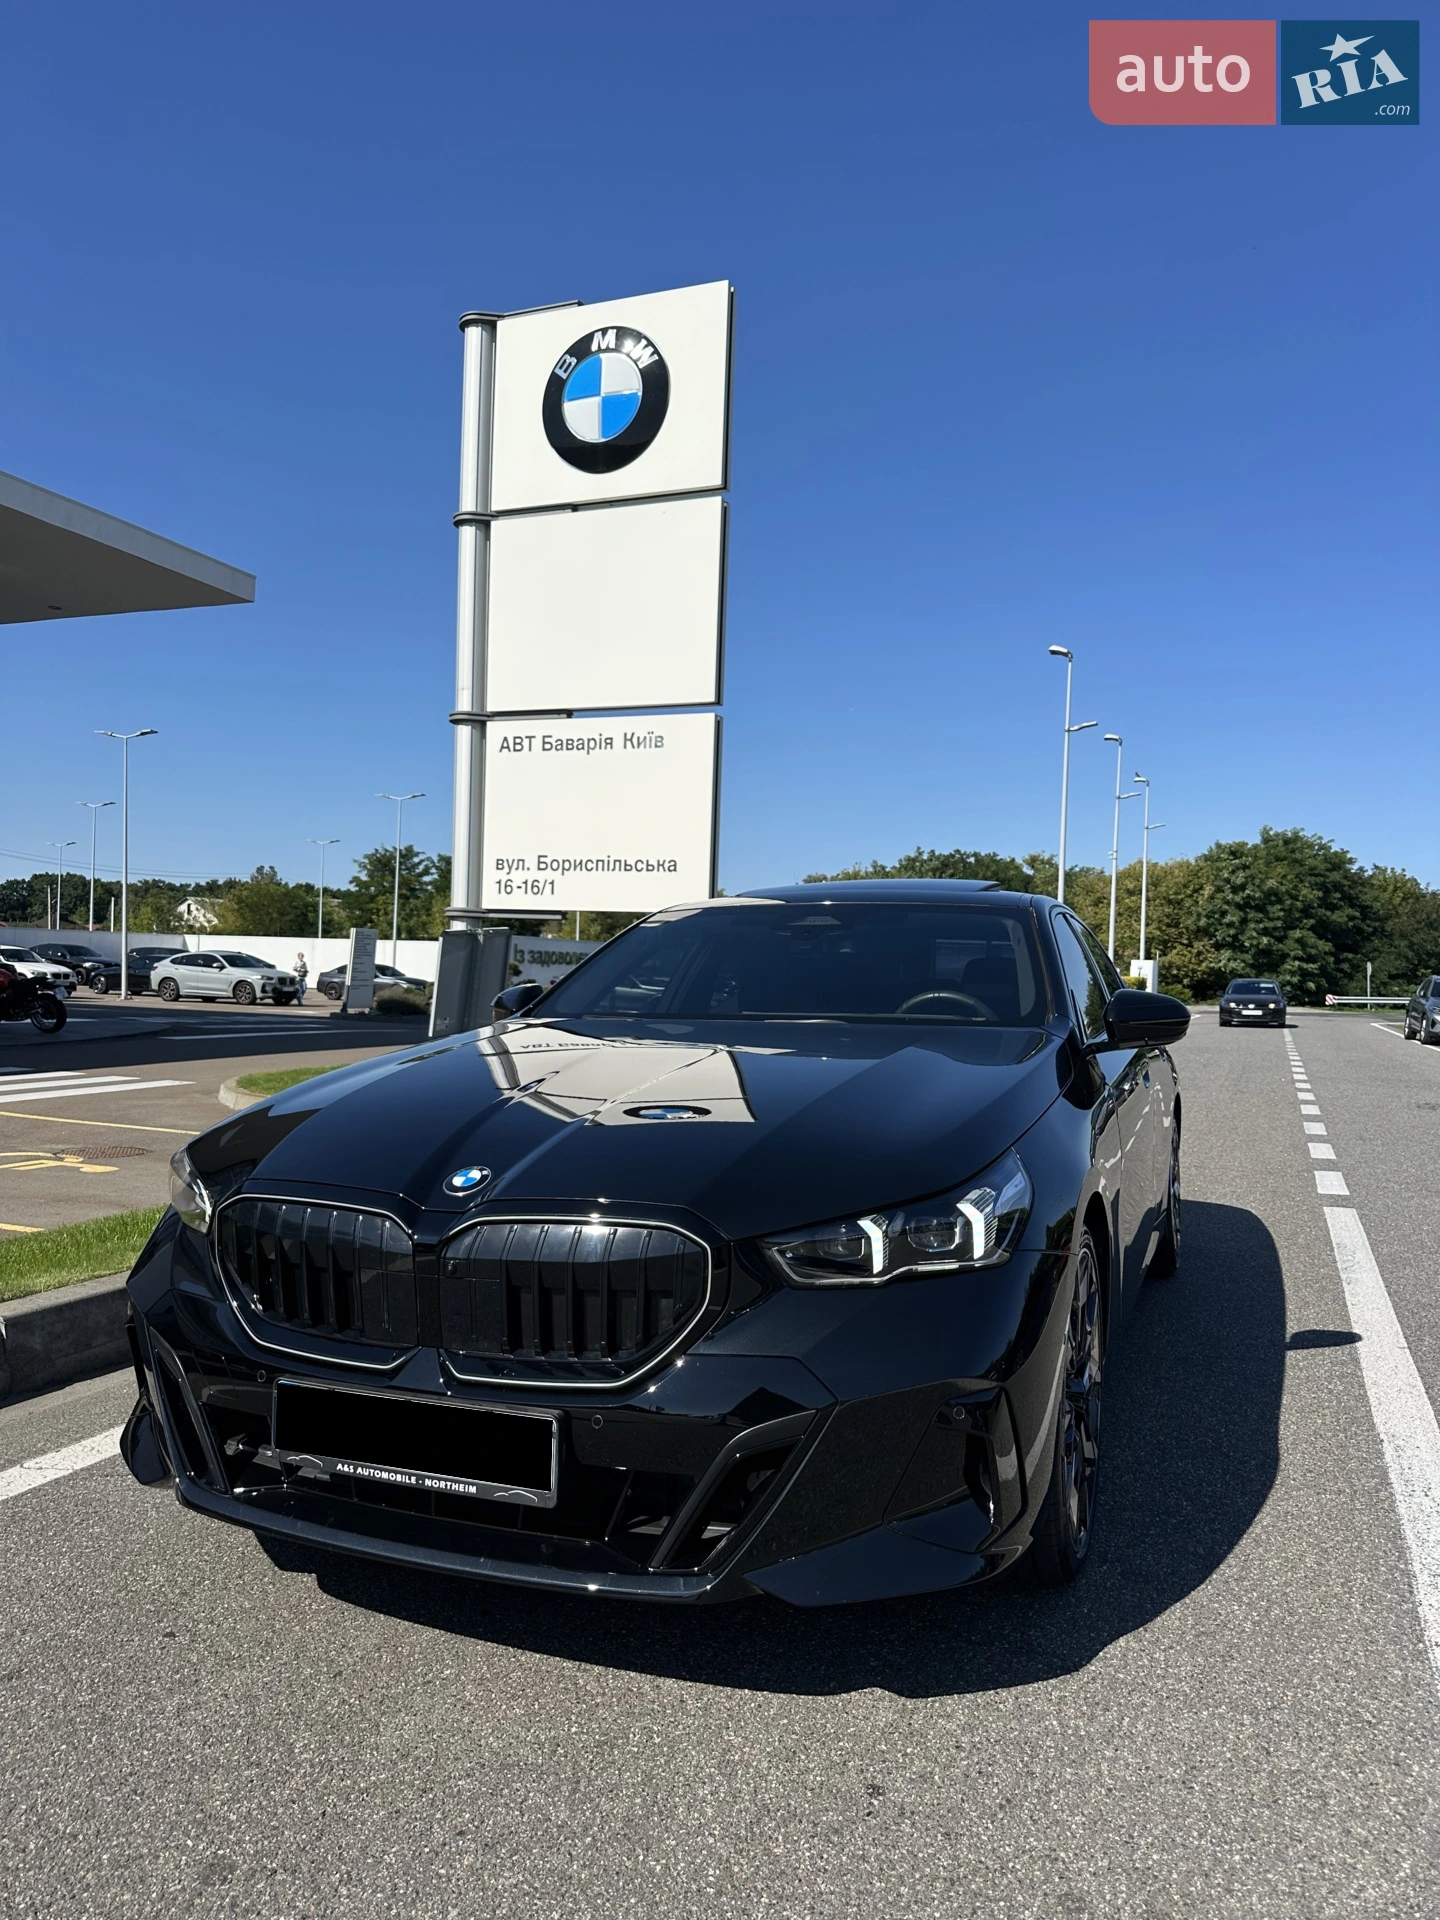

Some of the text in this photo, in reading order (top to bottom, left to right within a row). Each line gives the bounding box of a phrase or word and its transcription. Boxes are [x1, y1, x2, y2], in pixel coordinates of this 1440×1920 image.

[553, 328, 659, 380] BMW
[499, 731, 665, 755] АВТ Баварія Київ
[495, 855, 678, 876] вул. Бориспільська
[336, 1463, 354, 1473] A&S
[356, 1467, 417, 1484] AUTOMOBILE
[424, 1479, 477, 1494] NORTHEIM
